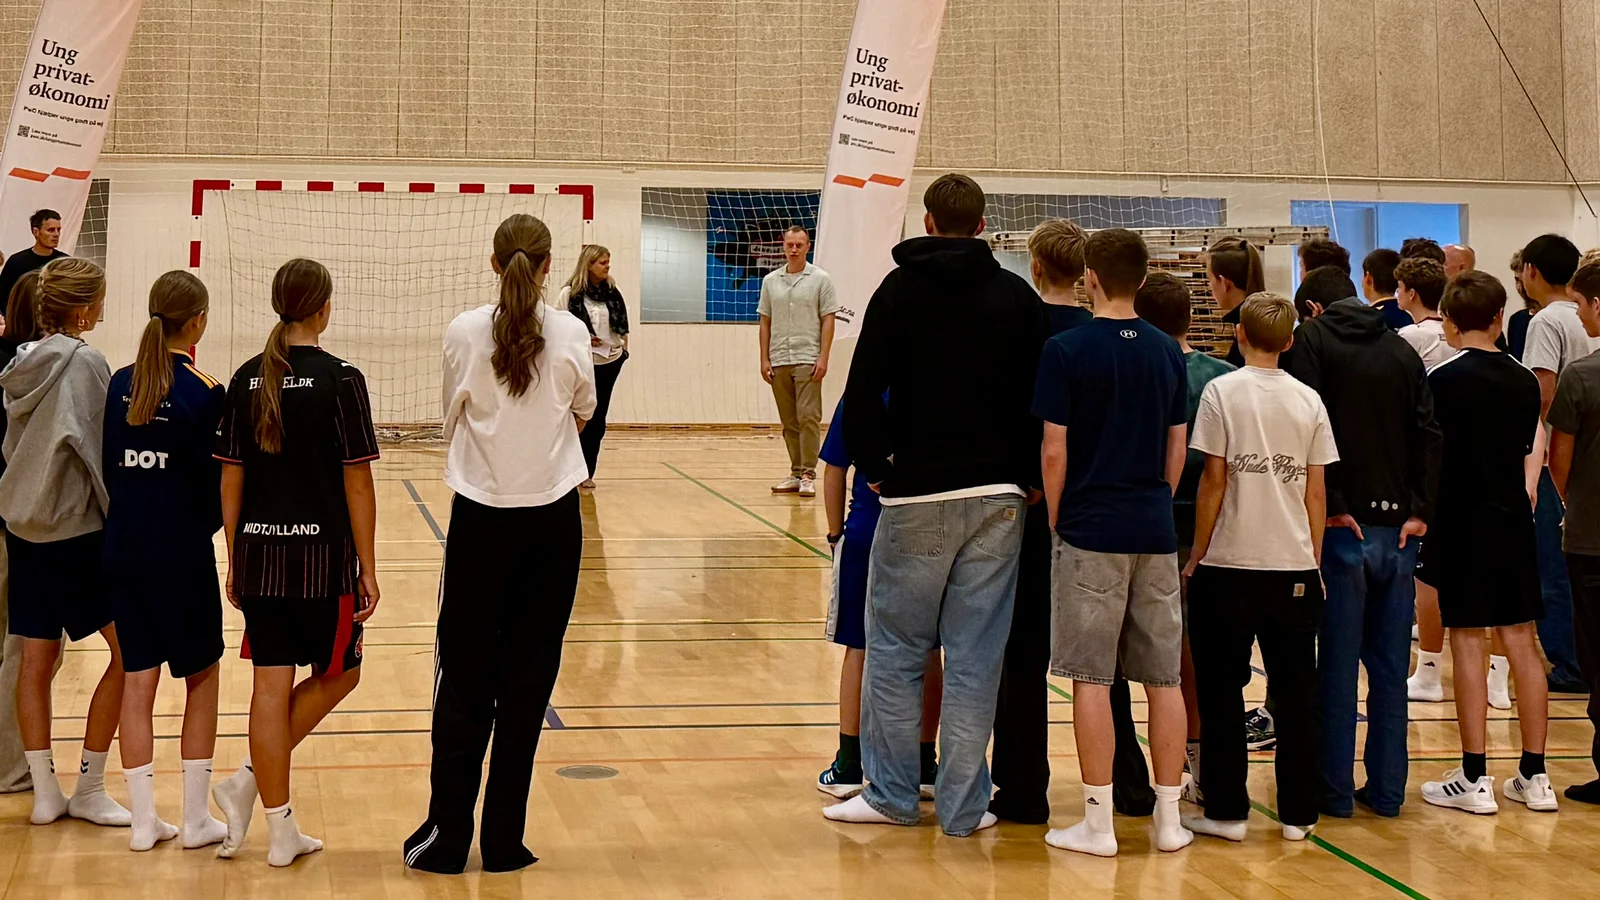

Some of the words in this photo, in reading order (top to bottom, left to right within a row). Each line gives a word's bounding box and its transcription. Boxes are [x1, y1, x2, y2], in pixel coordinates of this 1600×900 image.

[42, 39, 79, 65] Ung
[856, 47, 889, 73] Ung
[33, 63, 95, 86] privat-
[849, 71, 904, 93] privat-
[29, 82, 110, 110] økonomi
[847, 90, 920, 118] økonomi
